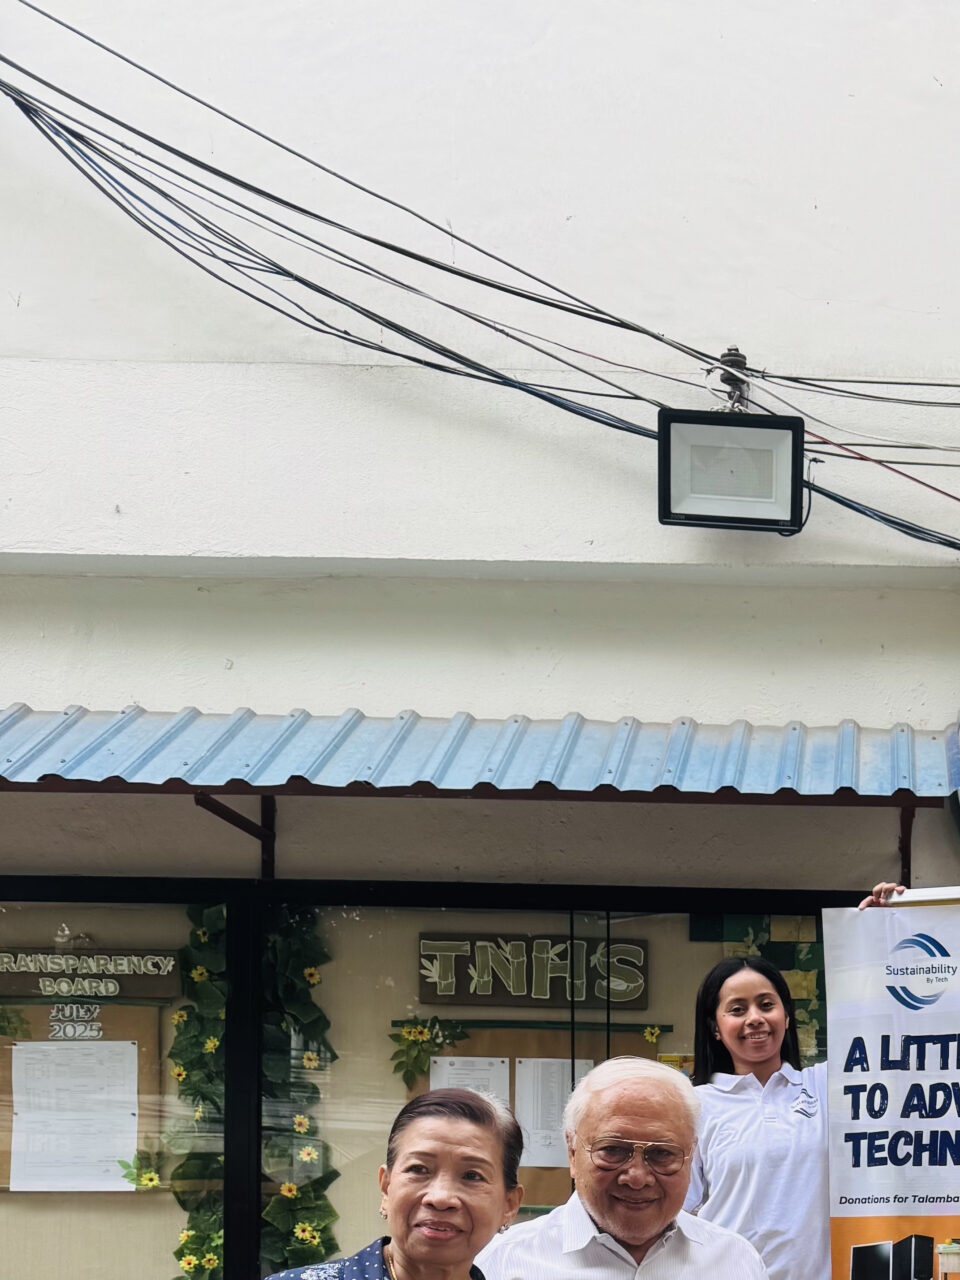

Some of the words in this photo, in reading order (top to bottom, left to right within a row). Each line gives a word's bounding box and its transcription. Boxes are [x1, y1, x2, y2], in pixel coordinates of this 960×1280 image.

[0, 953, 175, 975] RANSPARENCY
[420, 939, 645, 1001] TNHS
[885, 963, 958, 976] Sustainability
[39, 977, 120, 997] BOARD
[926, 976, 934, 984] By
[49, 1004, 101, 1021] JULY
[48, 1022, 103, 1040] 2025
[843, 1036, 870, 1072] A
[843, 1082, 889, 1120] TO
[839, 1194, 891, 1205] Donations
[893, 1194, 909, 1204] for
